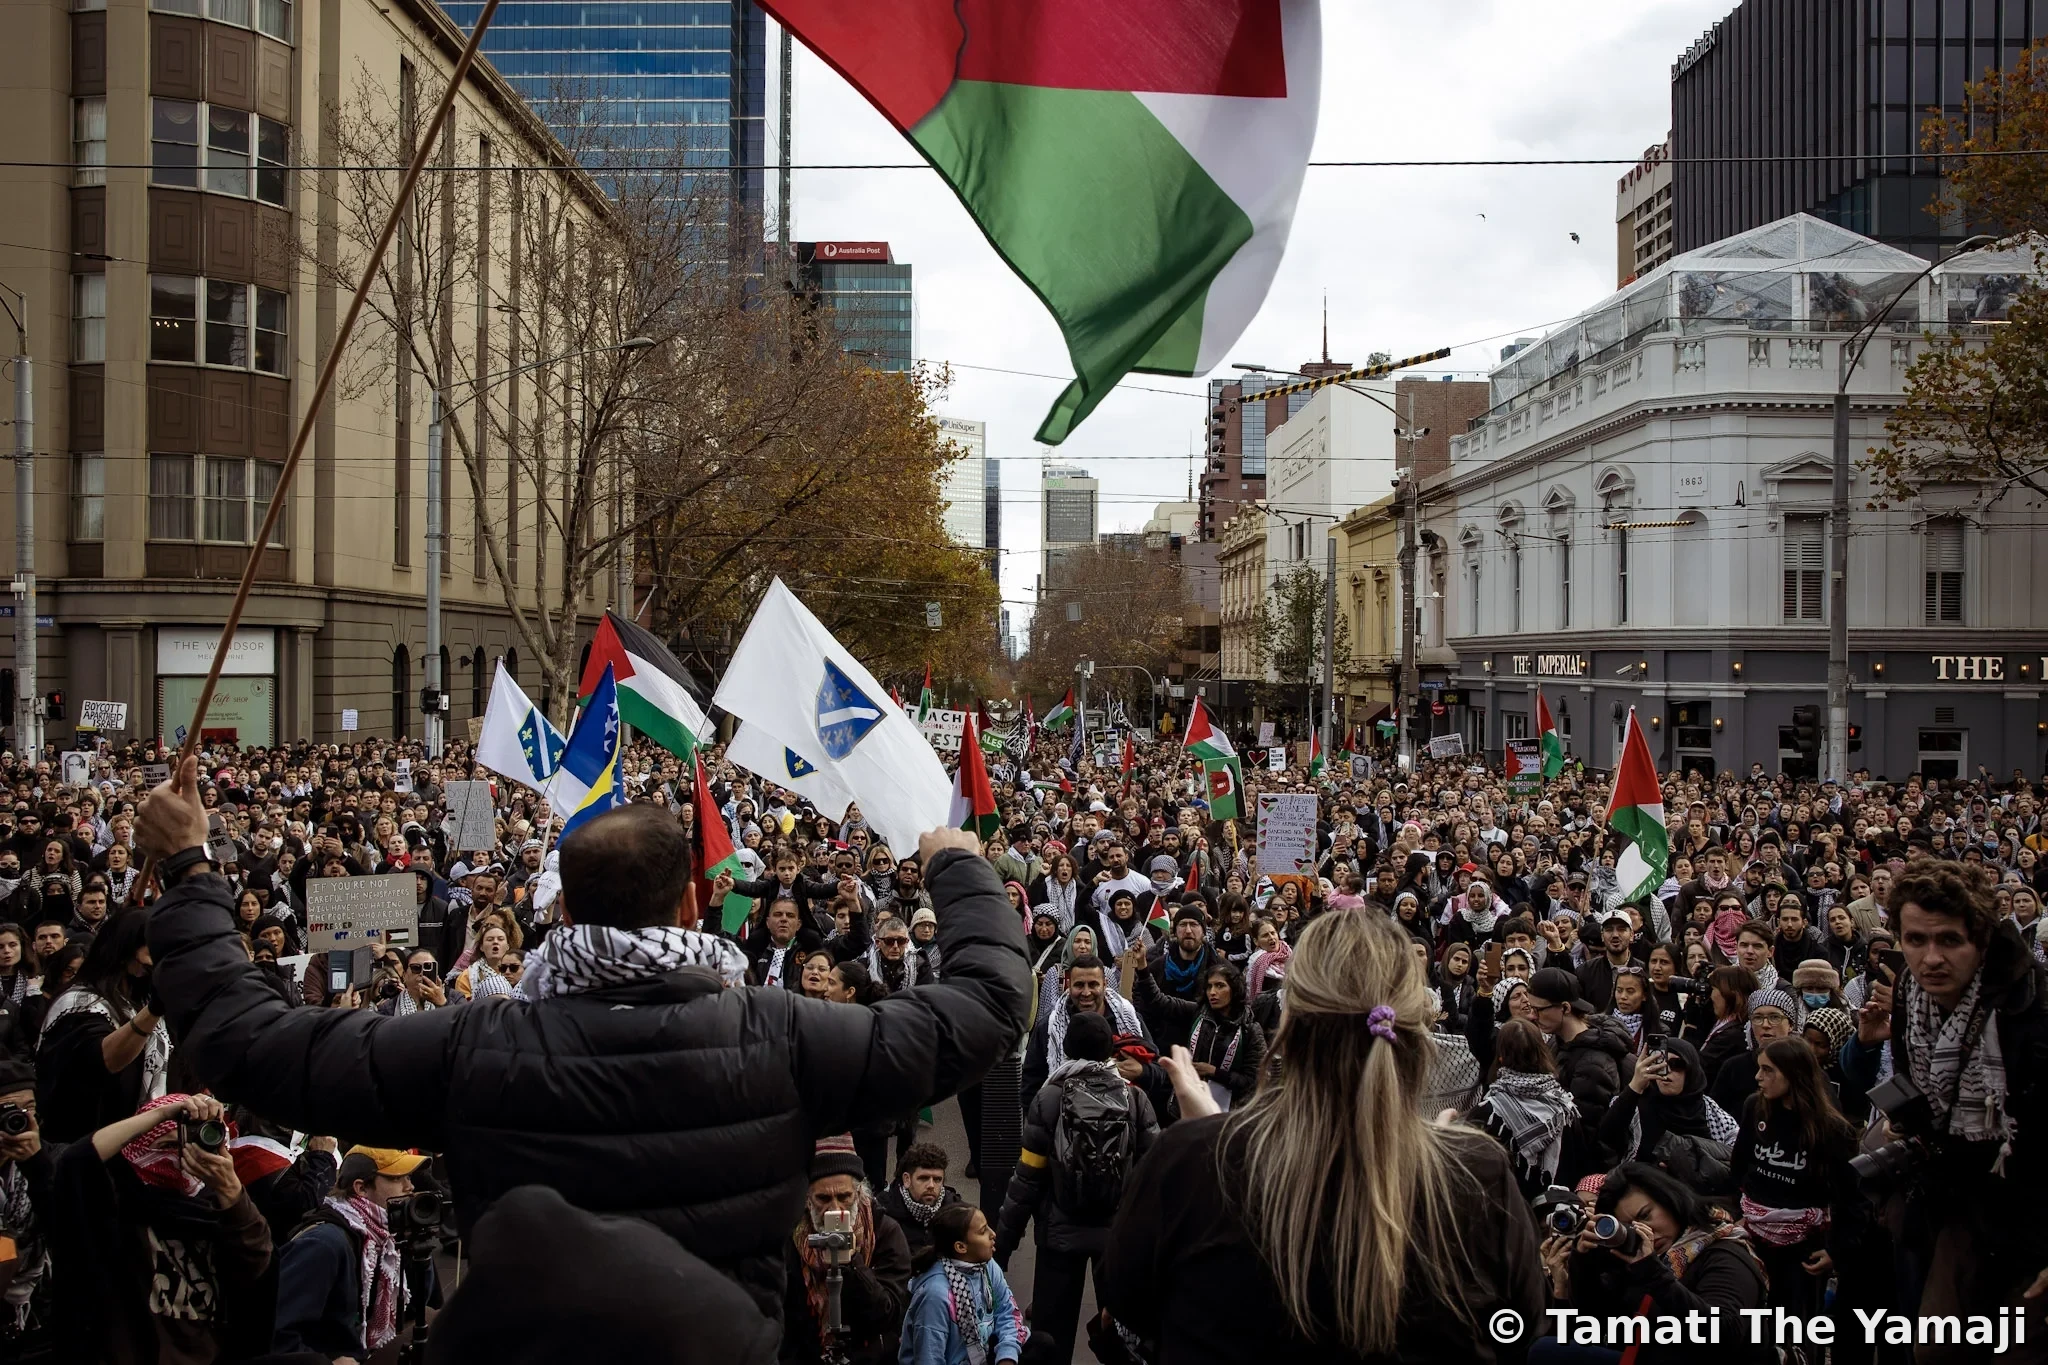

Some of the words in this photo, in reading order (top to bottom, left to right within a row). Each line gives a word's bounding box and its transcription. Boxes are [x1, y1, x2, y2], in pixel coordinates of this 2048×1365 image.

[948, 420, 976, 432] UniSuper
[1681, 476, 1702, 486] 1863
[174, 642, 200, 650] THE
[1538, 654, 1582, 676] IMPERIAL
[1932, 656, 2004, 680] THE
[212, 692, 230, 706] Gift
[84, 702, 122, 713] BOYCOTT
[83, 711, 123, 721] APARTHEID
[93, 720, 122, 729] ISRAEL
[924, 721, 945, 729] SCHOOL
[313, 883, 327, 893] IF
[370, 879, 390, 888] NOT
[308, 893, 342, 904] CAREFUL
[345, 892, 360, 901] THE
[363, 888, 410, 899] NEWSPAPERS
[332, 904, 350, 912] HAVE
[370, 901, 402, 909] HATING
[328, 912, 355, 920] PEOPLE
[377, 910, 392, 918] ARE
[395, 908, 417, 916] BEING
[310, 921, 352, 932] OPPRESSED
[355, 920, 369, 928] AND
[334, 929, 380, 940] OPPRESSORS
[1754, 1141, 1807, 1170] فلسطين
[1756, 1166, 1796, 1184] PALESTINE
